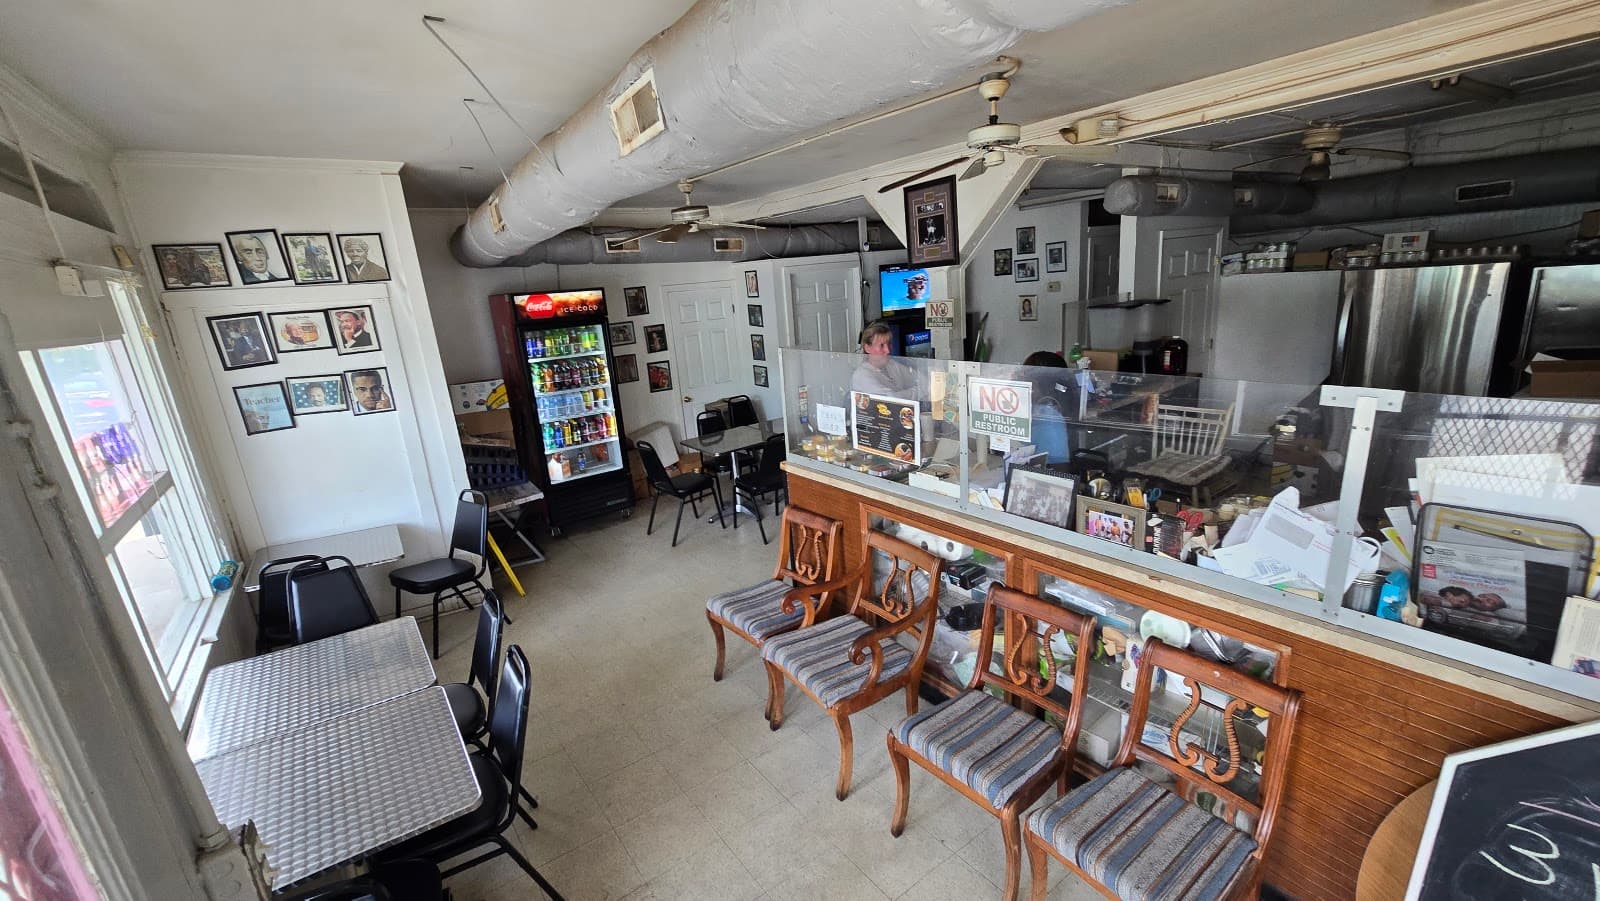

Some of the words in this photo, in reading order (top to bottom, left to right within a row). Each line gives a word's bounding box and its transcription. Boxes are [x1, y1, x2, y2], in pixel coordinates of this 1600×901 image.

[577, 304, 598, 312] COLD
[929, 302, 949, 317] NO
[243, 396, 281, 406] Teacher
[979, 385, 1020, 415] NO
[983, 413, 1017, 425] PUBLIC
[975, 420, 1025, 436] RESTROOM
